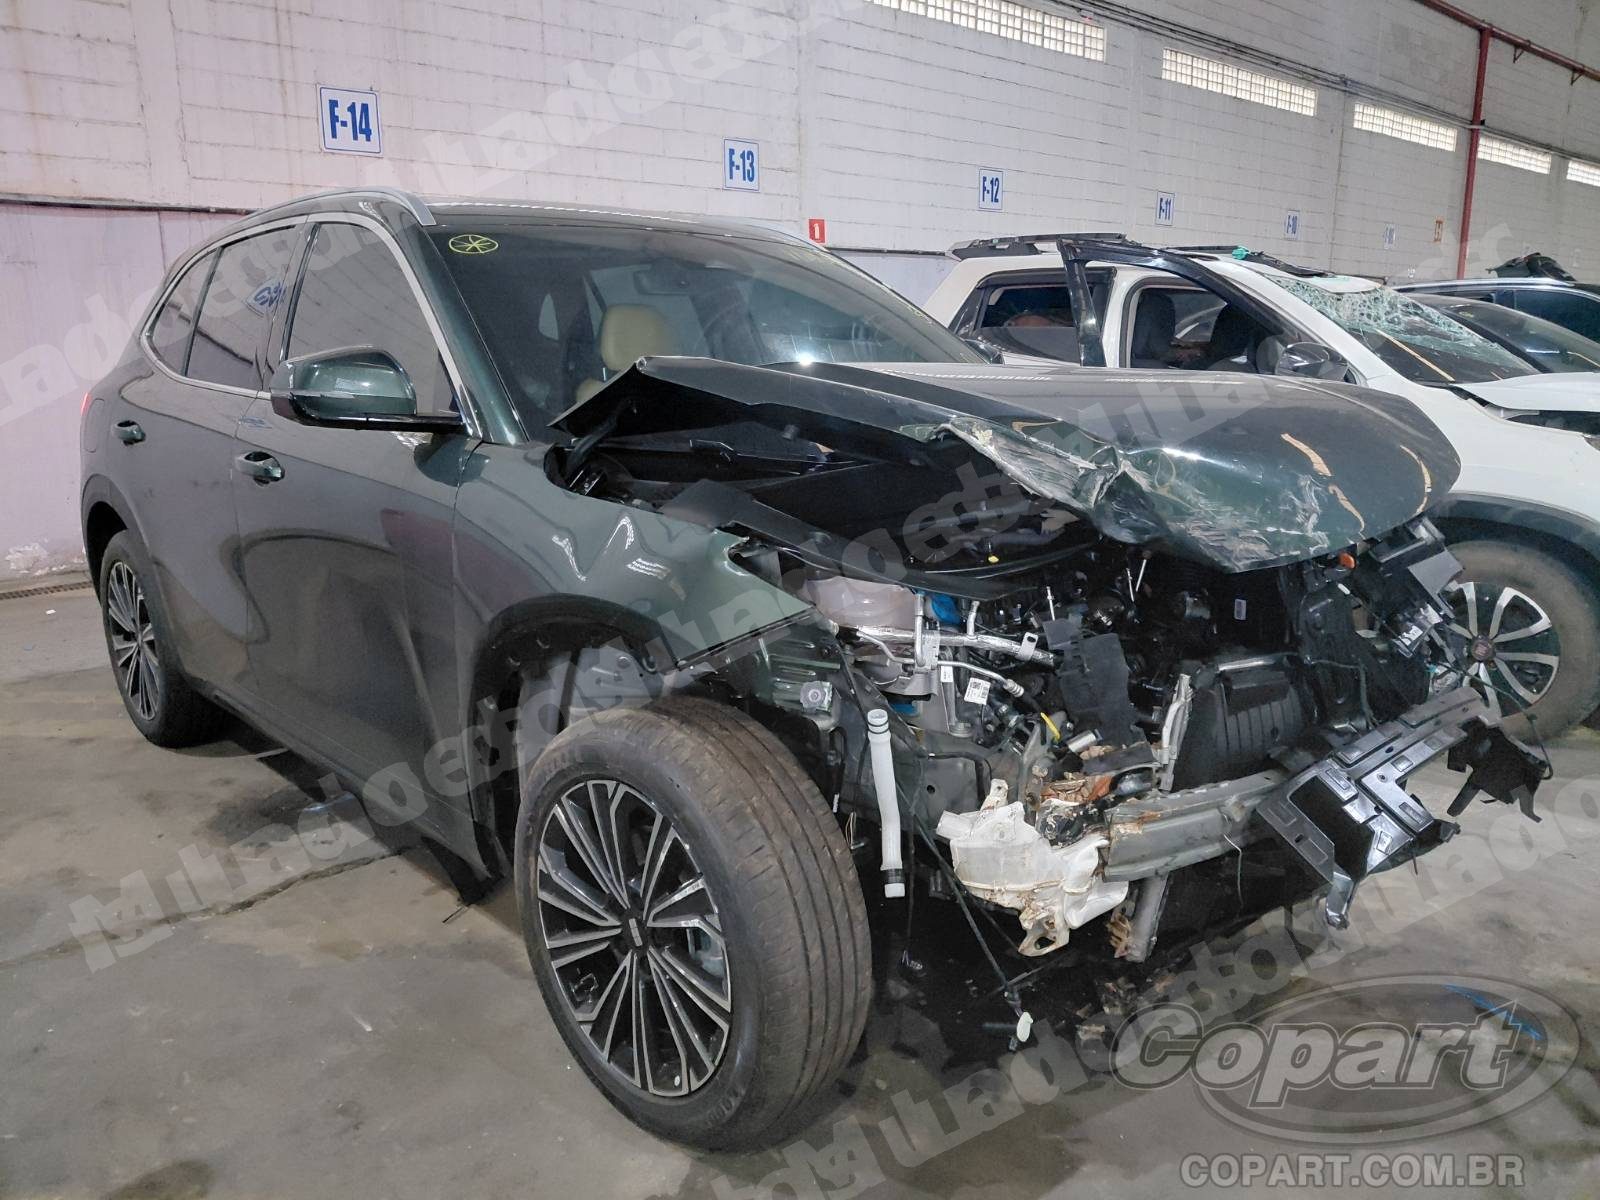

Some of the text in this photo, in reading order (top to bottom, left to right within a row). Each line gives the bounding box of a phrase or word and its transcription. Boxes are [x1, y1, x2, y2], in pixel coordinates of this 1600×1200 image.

[328, 99, 372, 142] F-14
[728, 148, 755, 182] F-13
[982, 175, 1000, 203] F-12
[1159, 197, 1171, 220] F-11
[813, 223, 820, 240] 1
